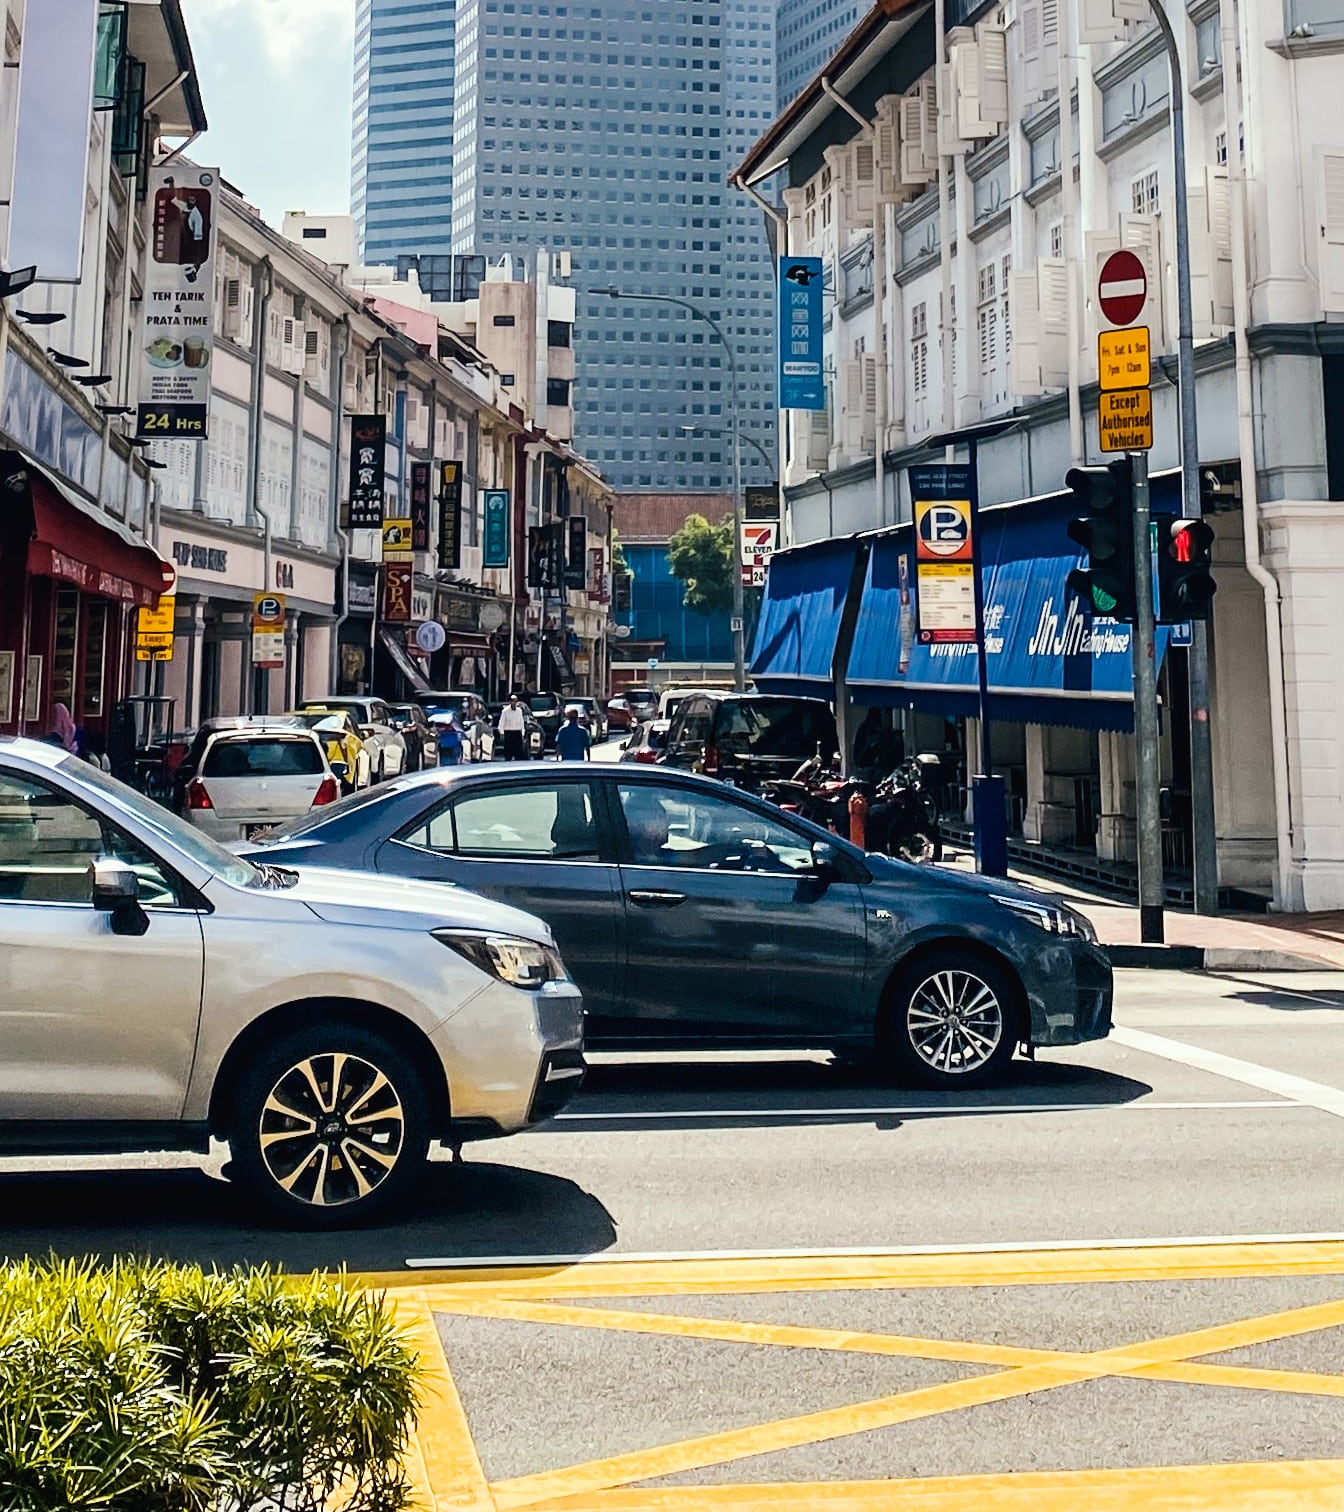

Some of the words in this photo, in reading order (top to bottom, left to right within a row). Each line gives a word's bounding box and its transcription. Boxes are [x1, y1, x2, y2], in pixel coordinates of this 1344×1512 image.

[152, 291, 172, 301] TEH
[174, 291, 205, 301] TARIK
[174, 304, 182, 313] &
[146, 315, 181, 326] PRATA
[183, 316, 209, 326] TIME
[1109, 392, 1140, 413] Except
[144, 413, 170, 430] 24
[176, 418, 202, 430] Hrs
[1102, 411, 1150, 430] Authorised
[1108, 432, 1145, 449] Vehicles
[929, 507, 964, 541] P
[753, 571, 764, 582] 24
[387, 569, 408, 613] SPA
